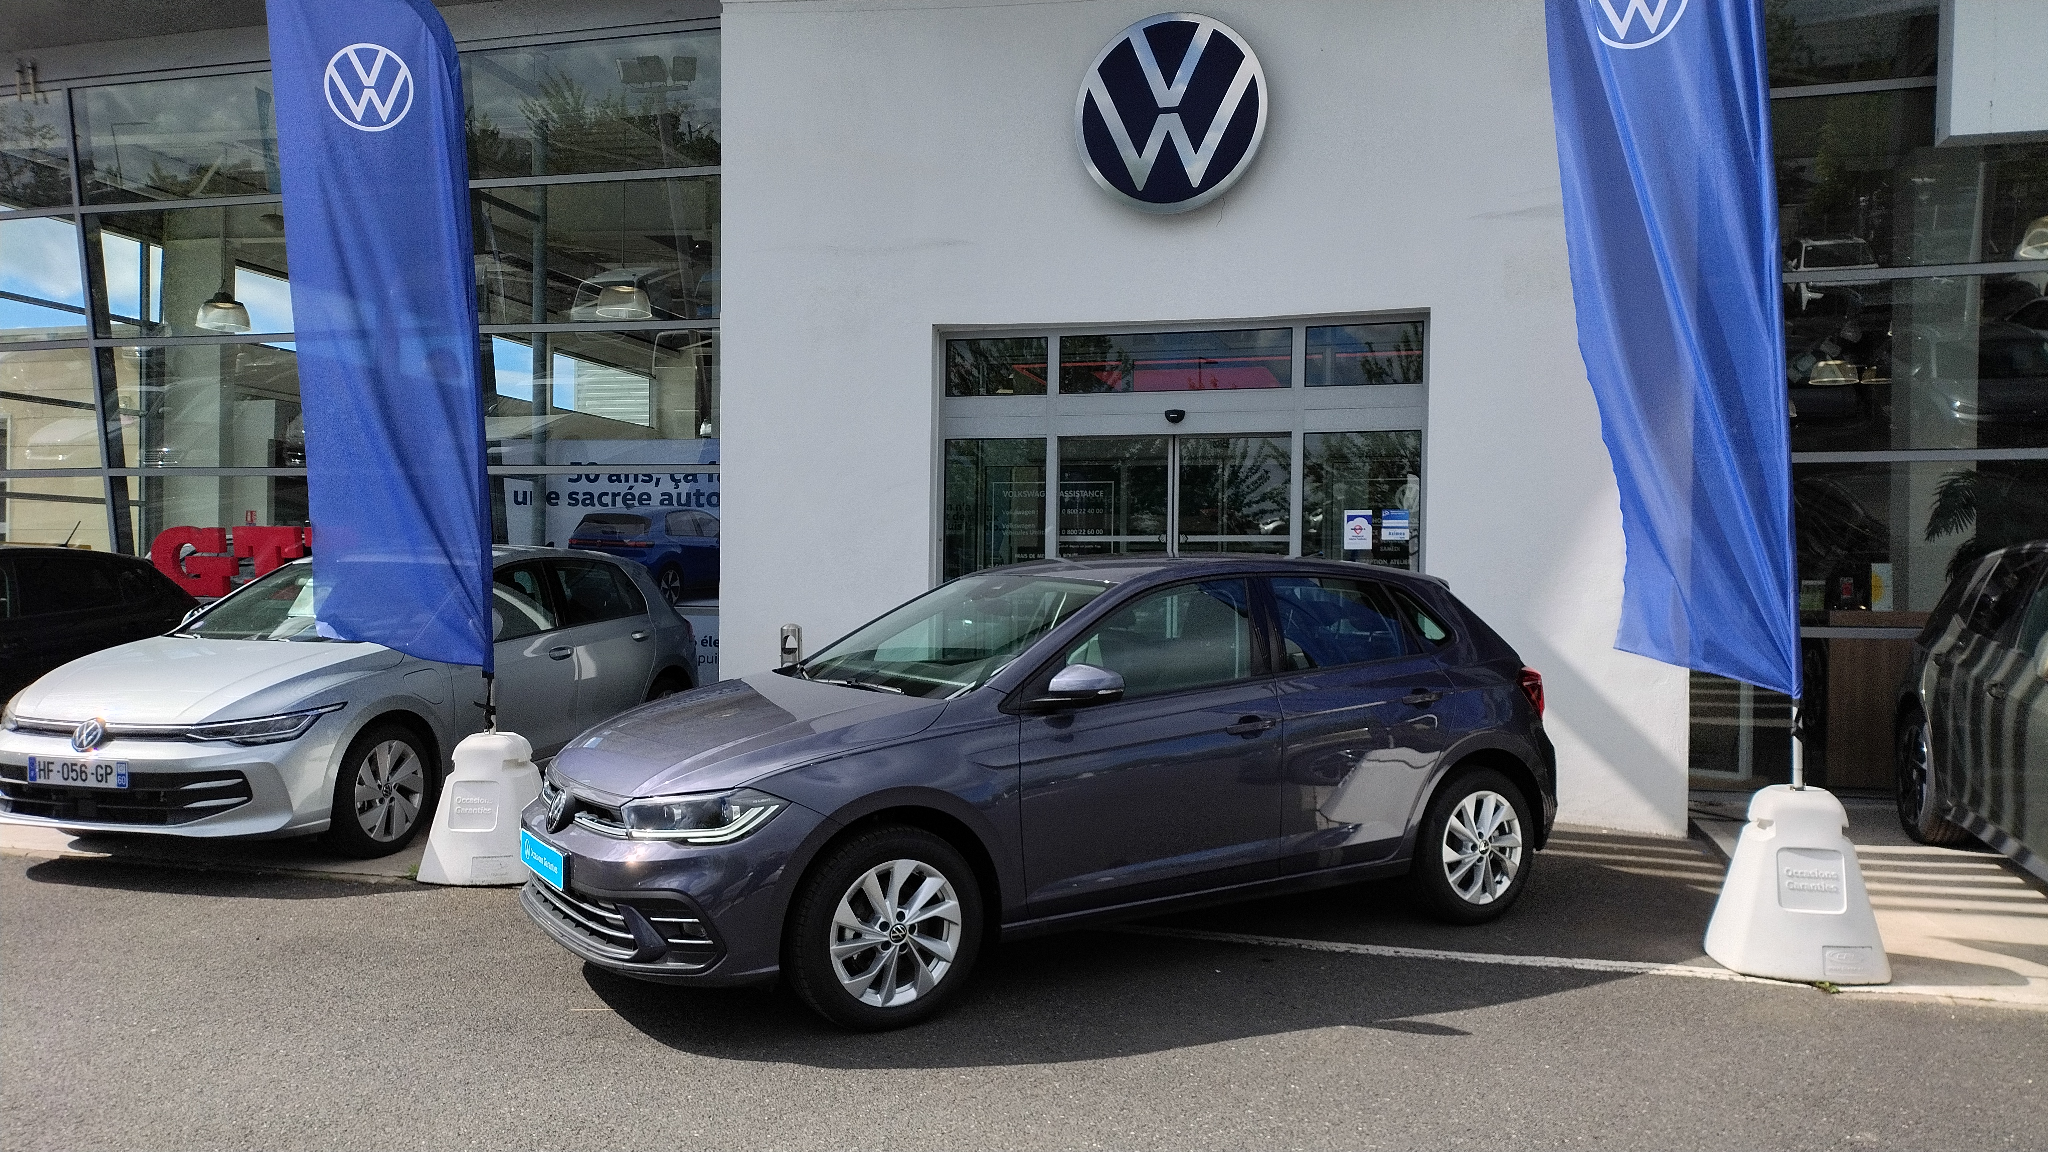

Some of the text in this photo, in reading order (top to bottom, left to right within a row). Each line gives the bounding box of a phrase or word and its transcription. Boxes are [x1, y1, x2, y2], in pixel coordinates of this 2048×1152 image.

[324, 44, 413, 128] VW
[1078, 15, 1262, 205] VW
[513, 485, 720, 508] ue sacrée auto
[1003, 490, 1104, 498] VOLKSWAG ASSISTANCE
[151, 526, 313, 597] GT
[38, 761, 114, 783] HF-056-GP
[1783, 867, 1839, 880] Occasions
[1785, 880, 1839, 893] Garanties
